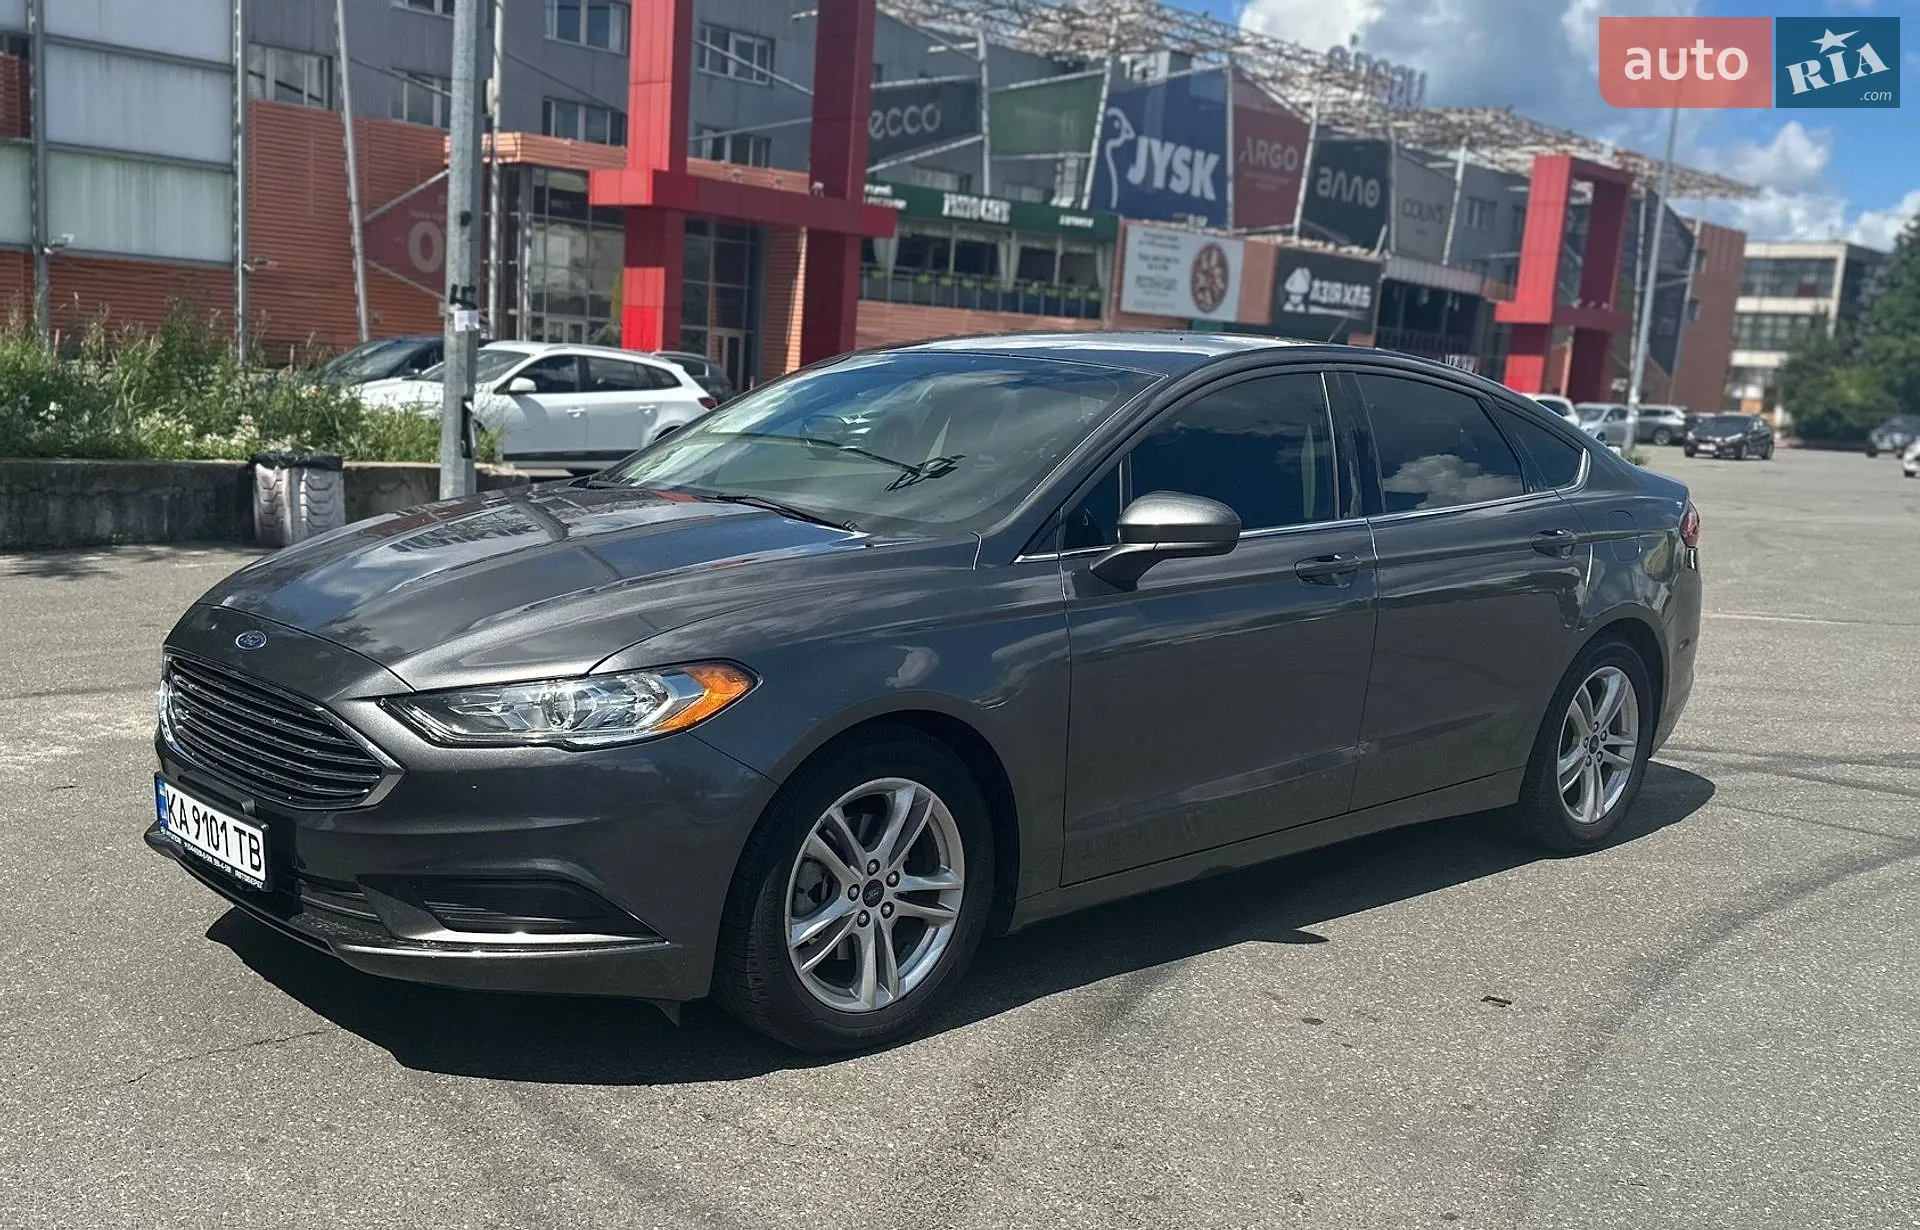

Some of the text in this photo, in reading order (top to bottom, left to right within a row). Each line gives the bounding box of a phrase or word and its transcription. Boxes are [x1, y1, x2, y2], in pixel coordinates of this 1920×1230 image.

[867, 103, 942, 140] ecco
[1126, 136, 1220, 202] JYSK
[1238, 136, 1299, 172] ARGO
[166, 789, 190, 835] KA
[192, 805, 230, 858] 9101
[233, 825, 262, 873] TB
